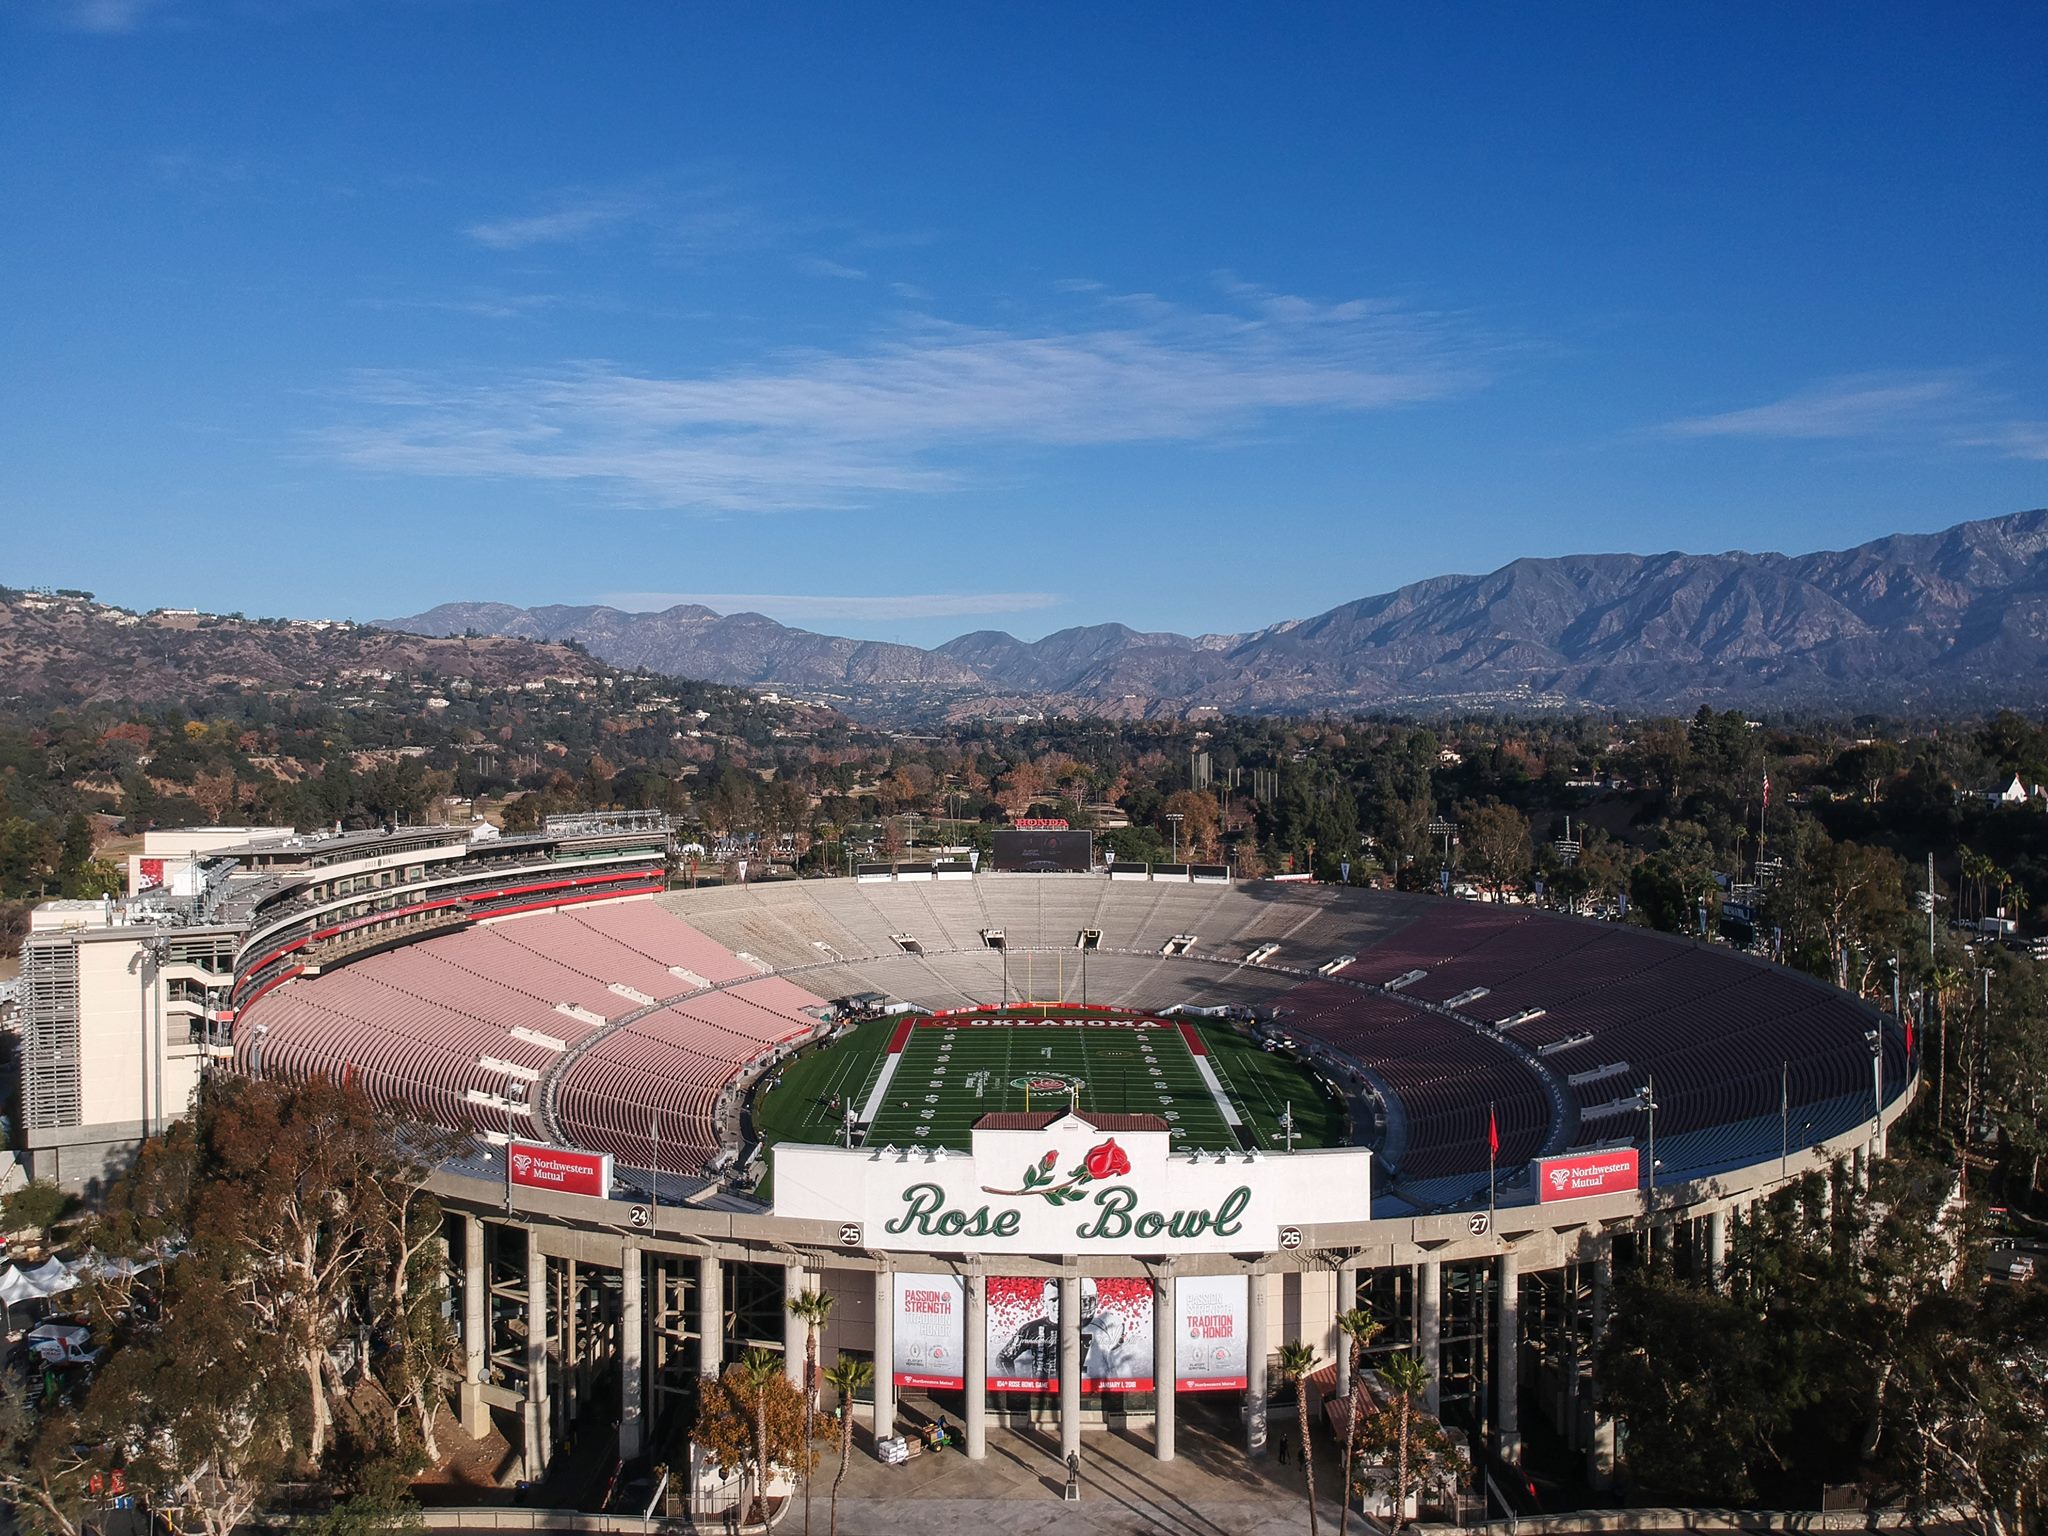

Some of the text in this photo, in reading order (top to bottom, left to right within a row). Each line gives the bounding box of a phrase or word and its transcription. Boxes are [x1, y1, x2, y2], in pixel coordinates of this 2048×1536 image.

[1014, 818, 1070, 827] HONDA
[971, 1019, 1161, 1028] OKLAHOMA
[533, 1157, 594, 1175] Northwestern
[1571, 1162, 1630, 1178] Northwestern
[533, 1168, 565, 1182] Mutual
[1571, 1175, 1603, 1188] Mutual
[631, 1210, 647, 1223] 24
[884, 1182, 1252, 1239] Rose Bowl
[1471, 1217, 1487, 1231] 27
[841, 1227, 859, 1241] 25
[1282, 1231, 1300, 1245] 26
[905, 1289, 940, 1302] PASSION
[904, 1301, 951, 1314] STRENGTH
[1187, 1315, 1233, 1327] TRADITION
[920, 1324, 951, 1337] HONOR
[1203, 1326, 1233, 1338] HONOR
